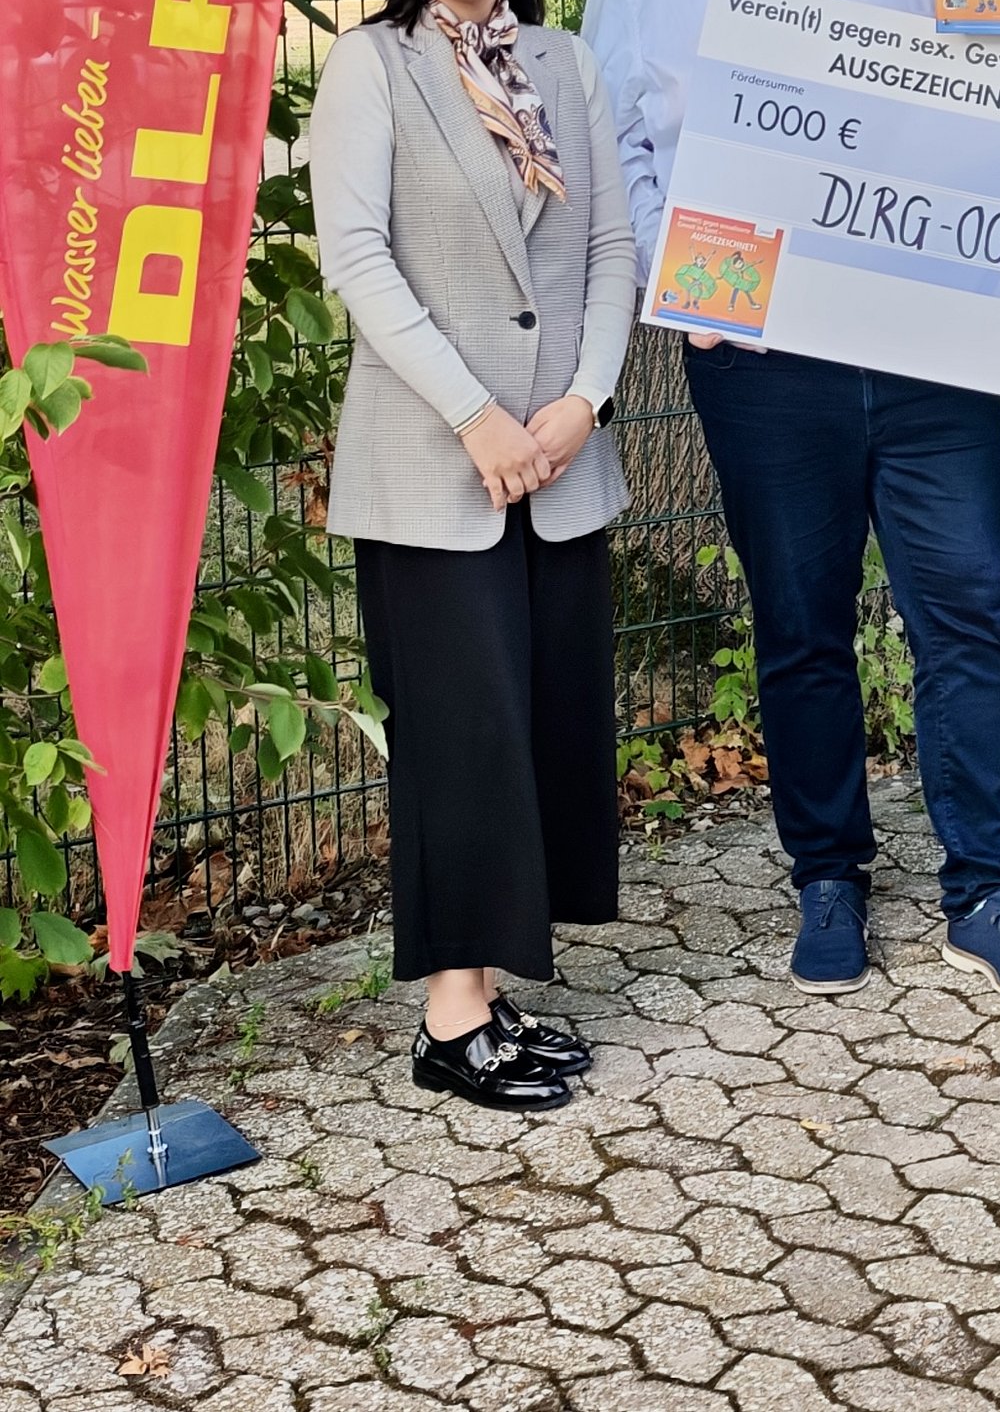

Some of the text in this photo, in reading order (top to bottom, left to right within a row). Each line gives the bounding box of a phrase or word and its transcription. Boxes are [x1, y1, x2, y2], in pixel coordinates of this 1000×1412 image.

[829, 19, 901, 48] gegen
[910, 36, 956, 60] sex.
[730, 70, 805, 95] Fördersumme
[61, 59, 110, 180] lieben
[733, 93, 862, 150] 1.000 €
[51, 187, 98, 336] Wasser
